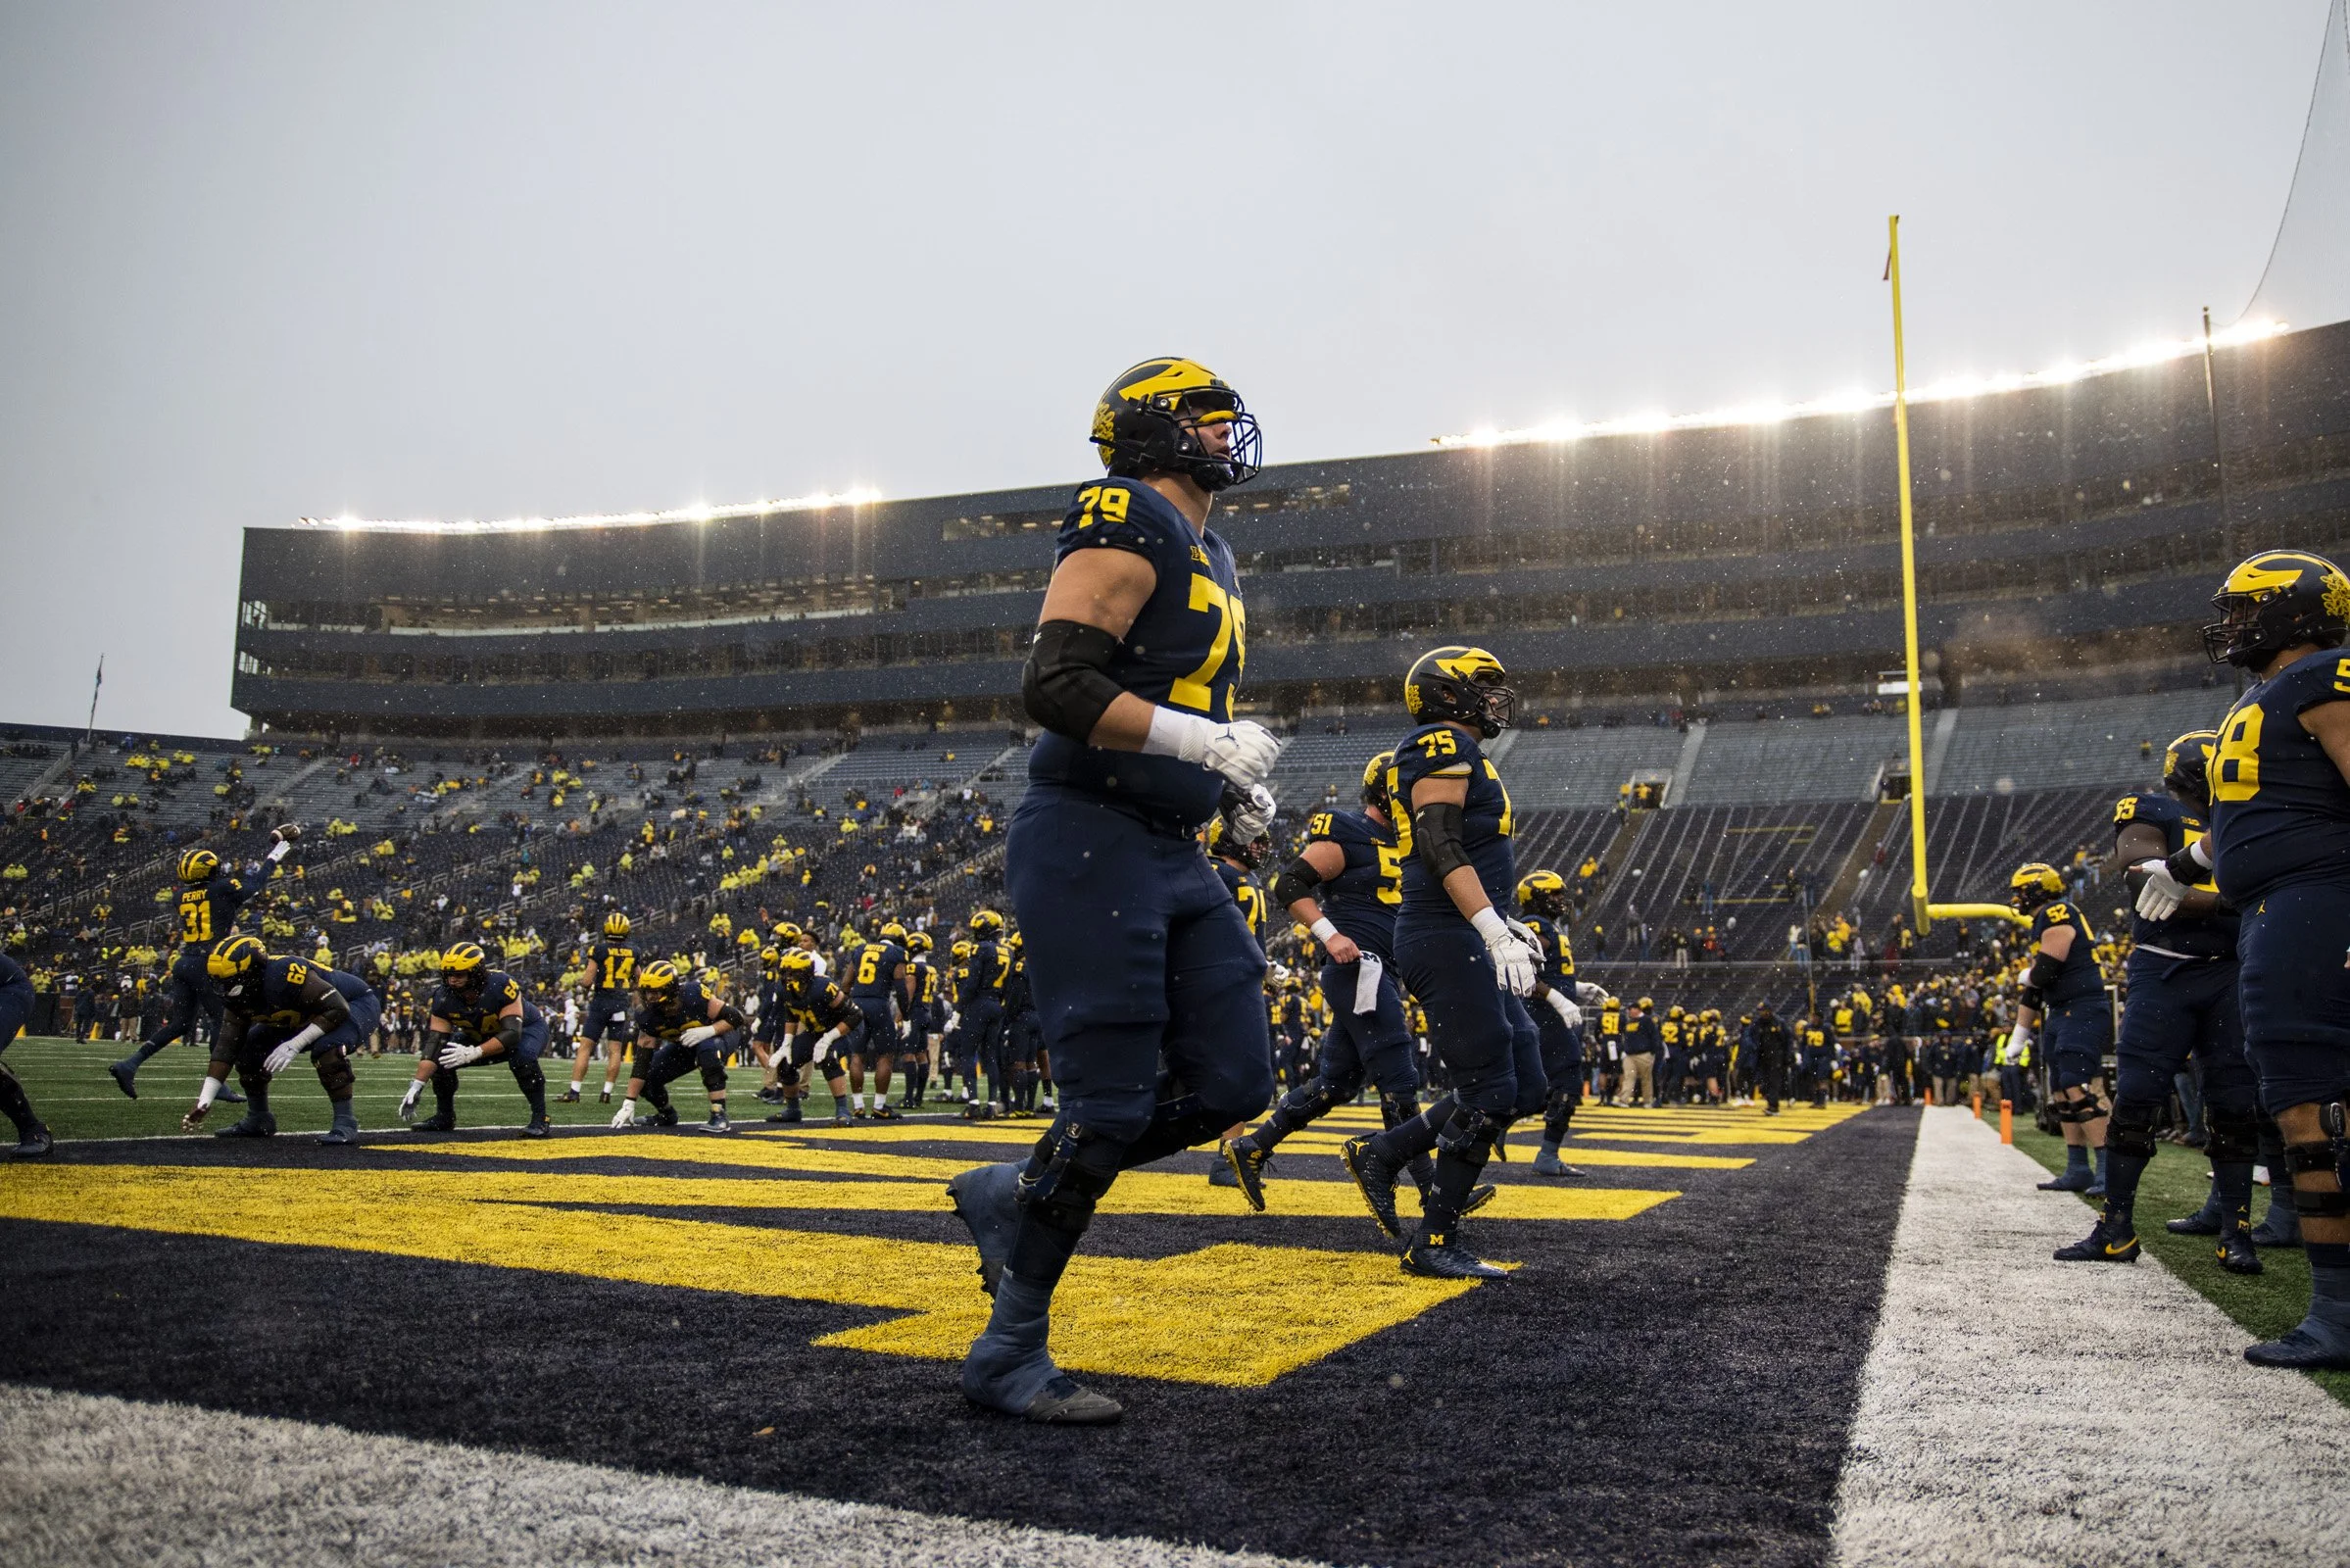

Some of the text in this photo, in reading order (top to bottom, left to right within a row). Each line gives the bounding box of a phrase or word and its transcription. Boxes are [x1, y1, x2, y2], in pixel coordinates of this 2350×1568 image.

[1078, 486, 1131, 529] 79
[1417, 730, 1457, 759] 75
[1311, 813, 1334, 835] 51
[182, 889, 208, 902] PERRY
[179, 901, 214, 942] 31
[2046, 904, 2071, 923] 52
[608, 948, 633, 956] WILSON
[287, 963, 307, 985] 62
[602, 956, 635, 989] 14
[857, 952, 880, 984] 6
[504, 978, 519, 999] 64
[1602, 1013, 1620, 1035] 91
[1429, 1234, 1444, 1246] M
